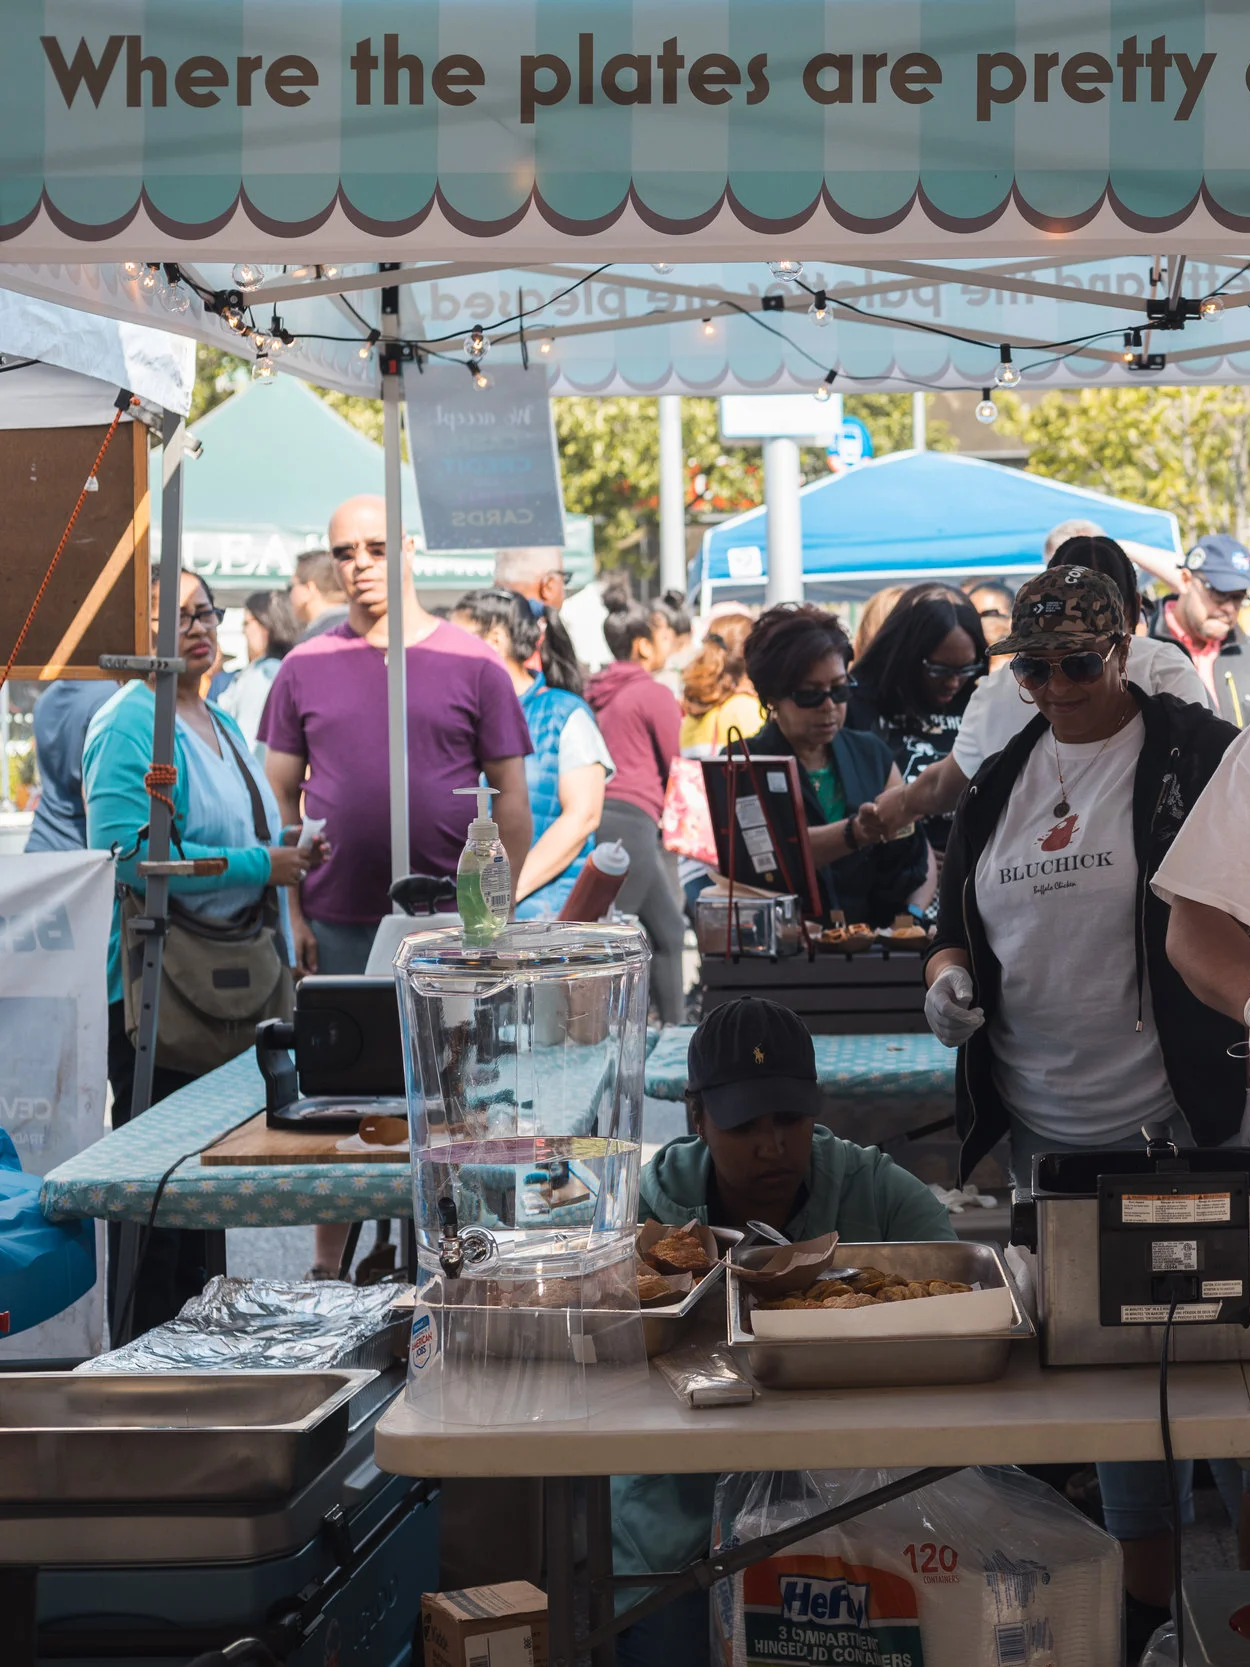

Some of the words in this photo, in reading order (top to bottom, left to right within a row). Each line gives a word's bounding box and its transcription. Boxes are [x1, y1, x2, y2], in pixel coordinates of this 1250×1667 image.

[39, 34, 319, 110] Where
[350, 33, 486, 107] the
[520, 32, 770, 124] plates
[802, 52, 943, 105] are
[976, 34, 1218, 122] pretty
[999, 851, 1114, 885] BLUCHICK
[1032, 884, 1054, 896] Buffalo
[1054, 880, 1077, 891] Chicken
[903, 1542, 959, 1574] 120
[922, 1574, 961, 1585] CONTAINERS
[777, 1625, 788, 1640] 3
[791, 1626, 880, 1652] CMPARTENT
[754, 1639, 807, 1657] HINGED
[831, 1647, 913, 1667] CONTAIERS
